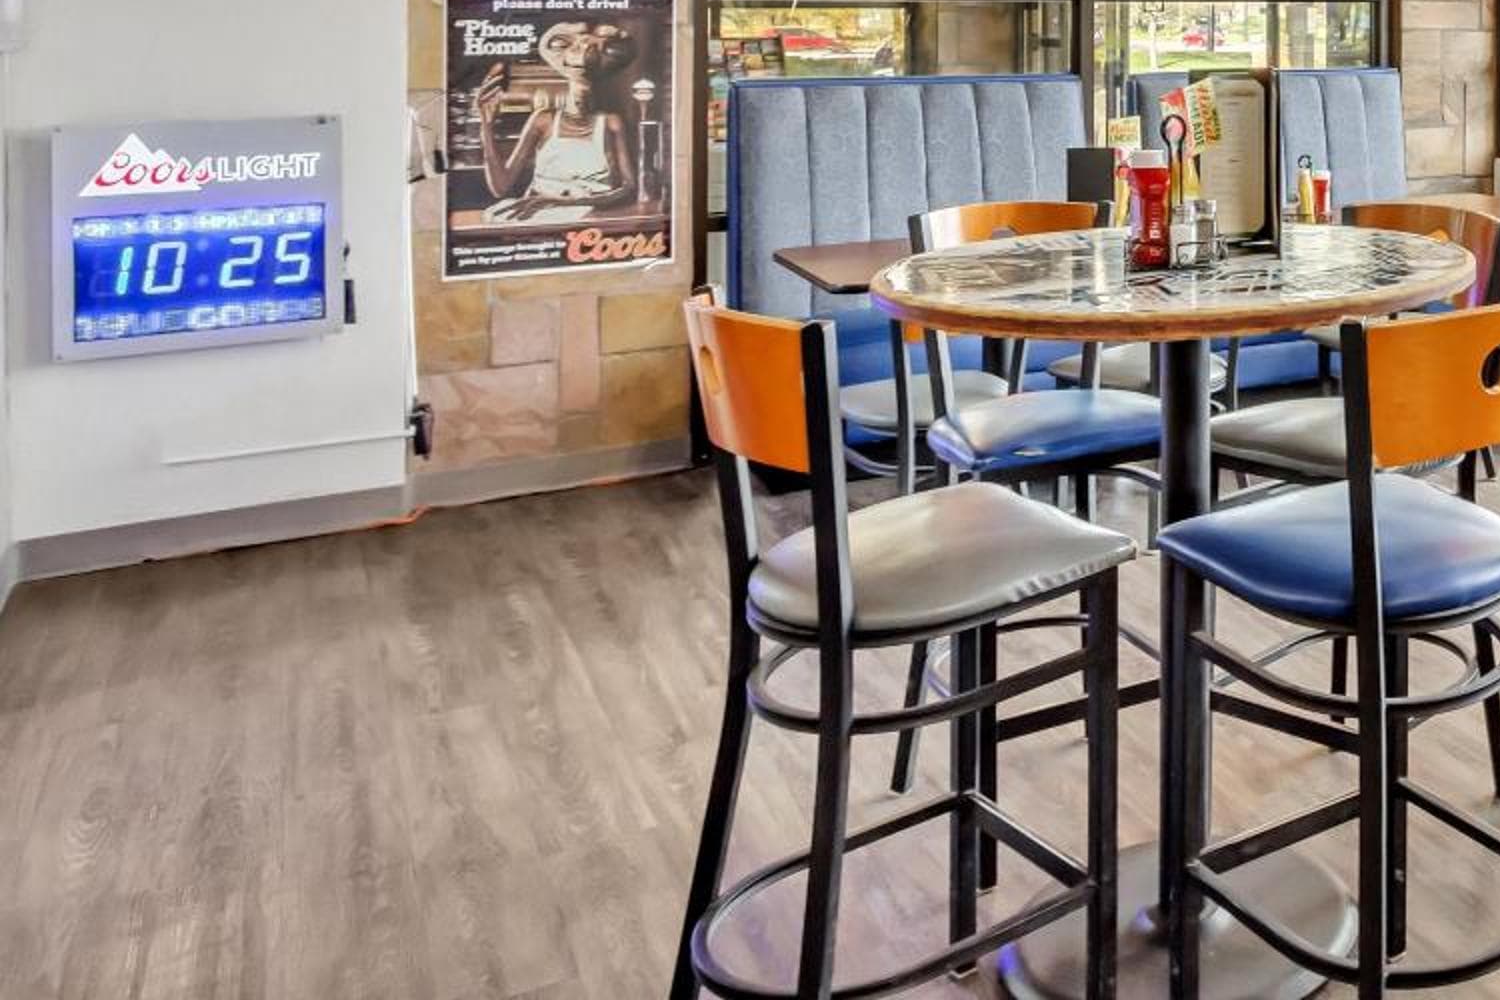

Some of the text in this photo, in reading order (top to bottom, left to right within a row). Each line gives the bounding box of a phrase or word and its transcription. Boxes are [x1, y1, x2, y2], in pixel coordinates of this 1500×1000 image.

[95, 151, 320, 187] Coors LIGHT
[565, 228, 666, 263] Coors
